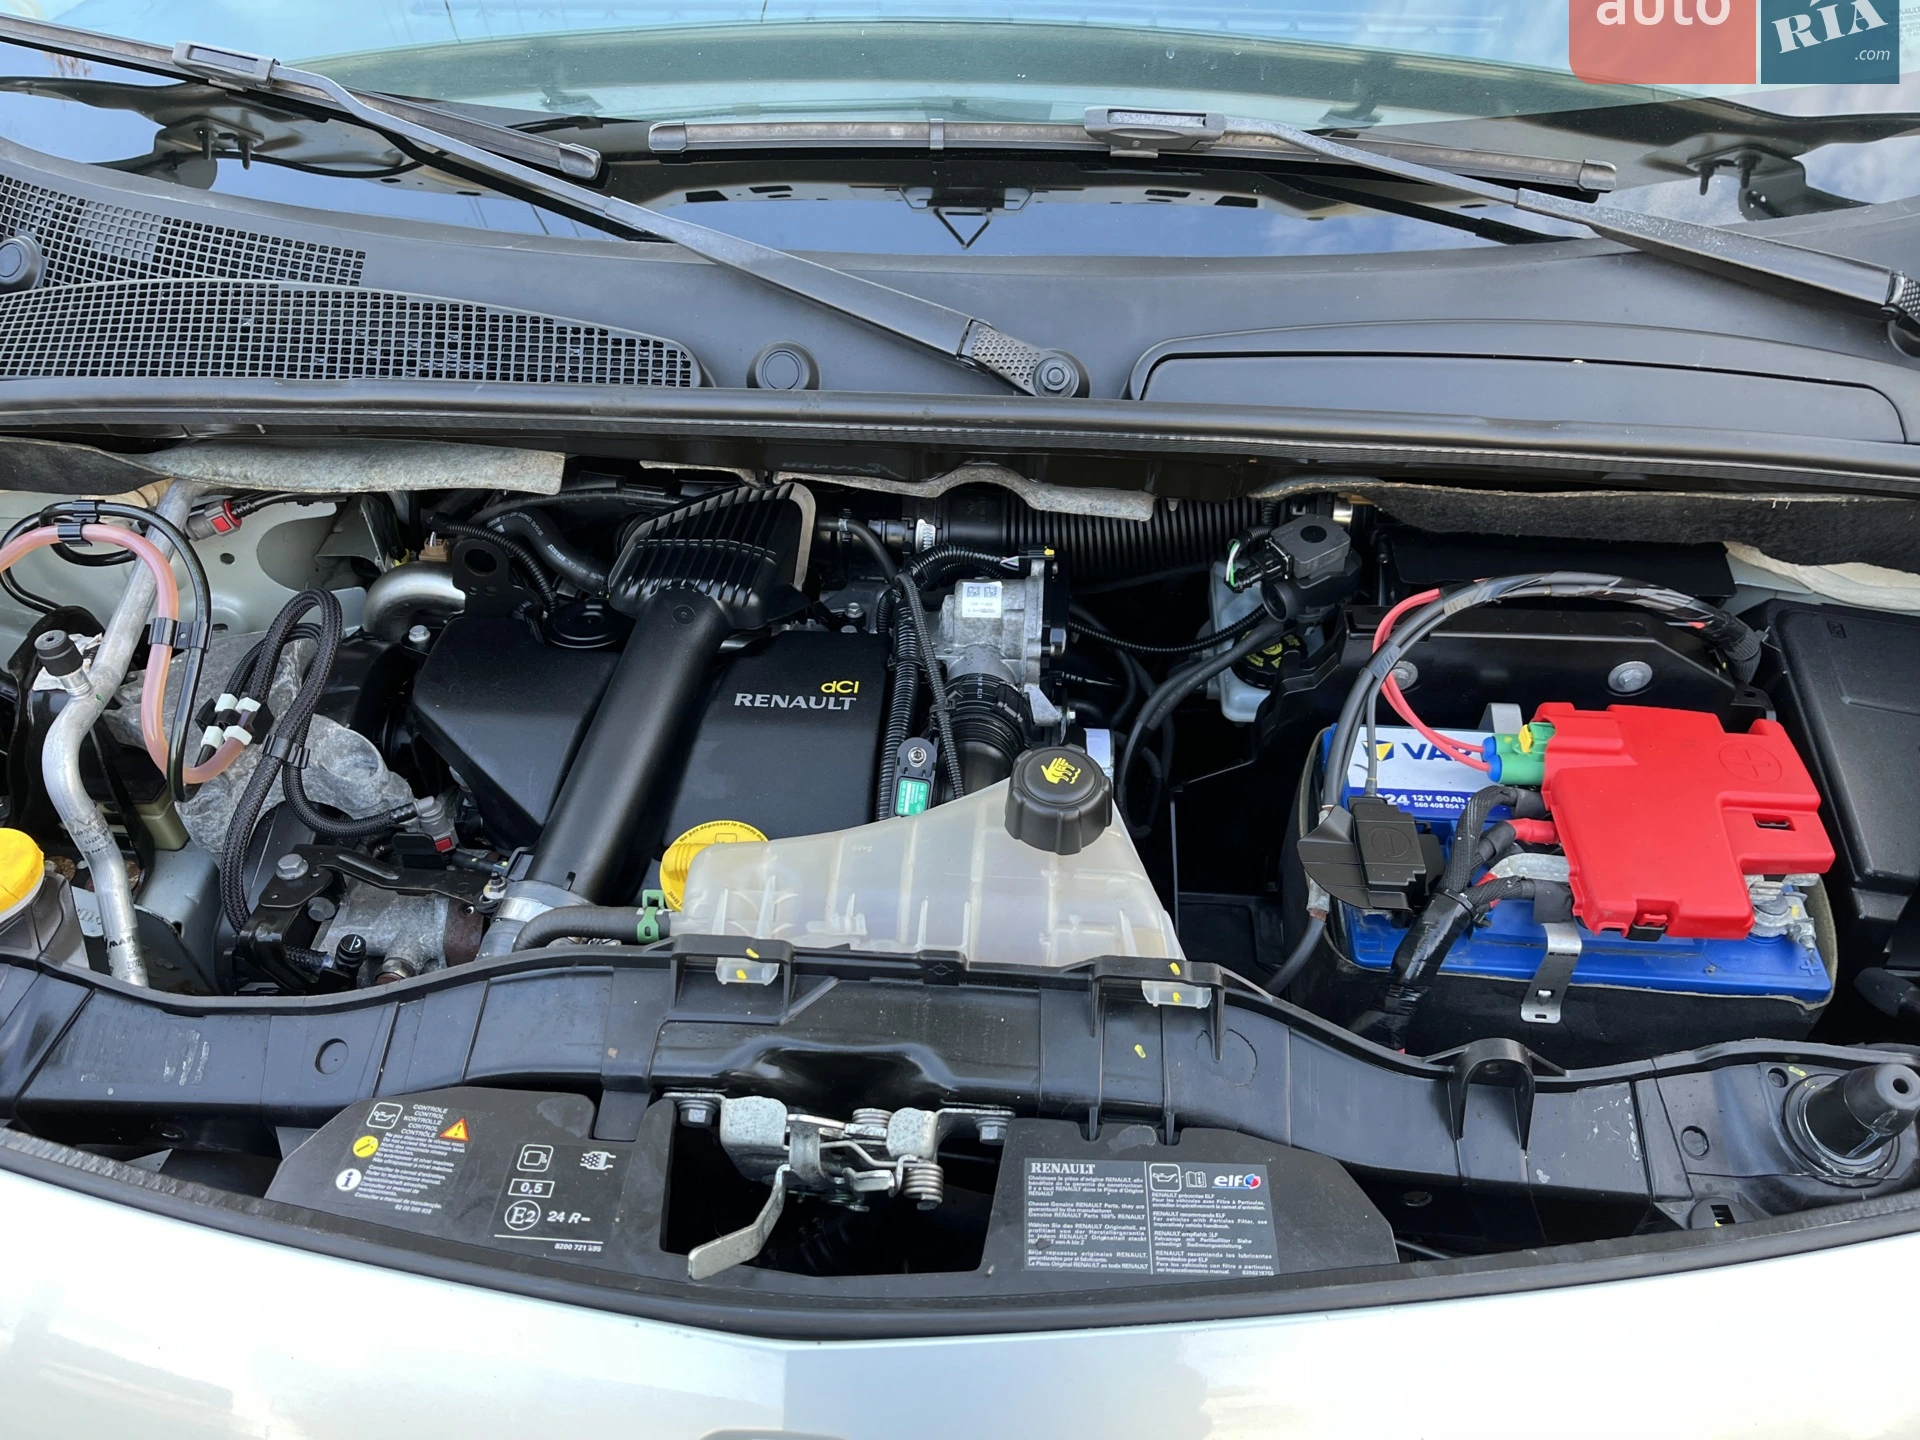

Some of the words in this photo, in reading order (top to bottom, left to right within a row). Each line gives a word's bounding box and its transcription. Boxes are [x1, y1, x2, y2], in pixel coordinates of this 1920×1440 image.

[734, 692, 857, 710] RENAULT
[1377, 793, 1410, 806] 24
[1411, 794, 1433, 802] 12V
[1435, 795, 1465, 803] 60Ah
[688, 827, 699, 837] pas
[699, 821, 731, 831] dépasser
[738, 823, 757, 835] niveau
[403, 1115, 443, 1126] KONTROLLE
[414, 1110, 444, 1120] CONTROL
[407, 1122, 439, 1132] CONTROL
[1031, 1162, 1096, 1175] RENAULT
[1213, 1174, 1244, 1187] elf
[520, 1182, 544, 1194] 0,5
[509, 1206, 537, 1225] E2
[547, 1211, 565, 1222] 24
[573, 1243, 586, 1251] 721
